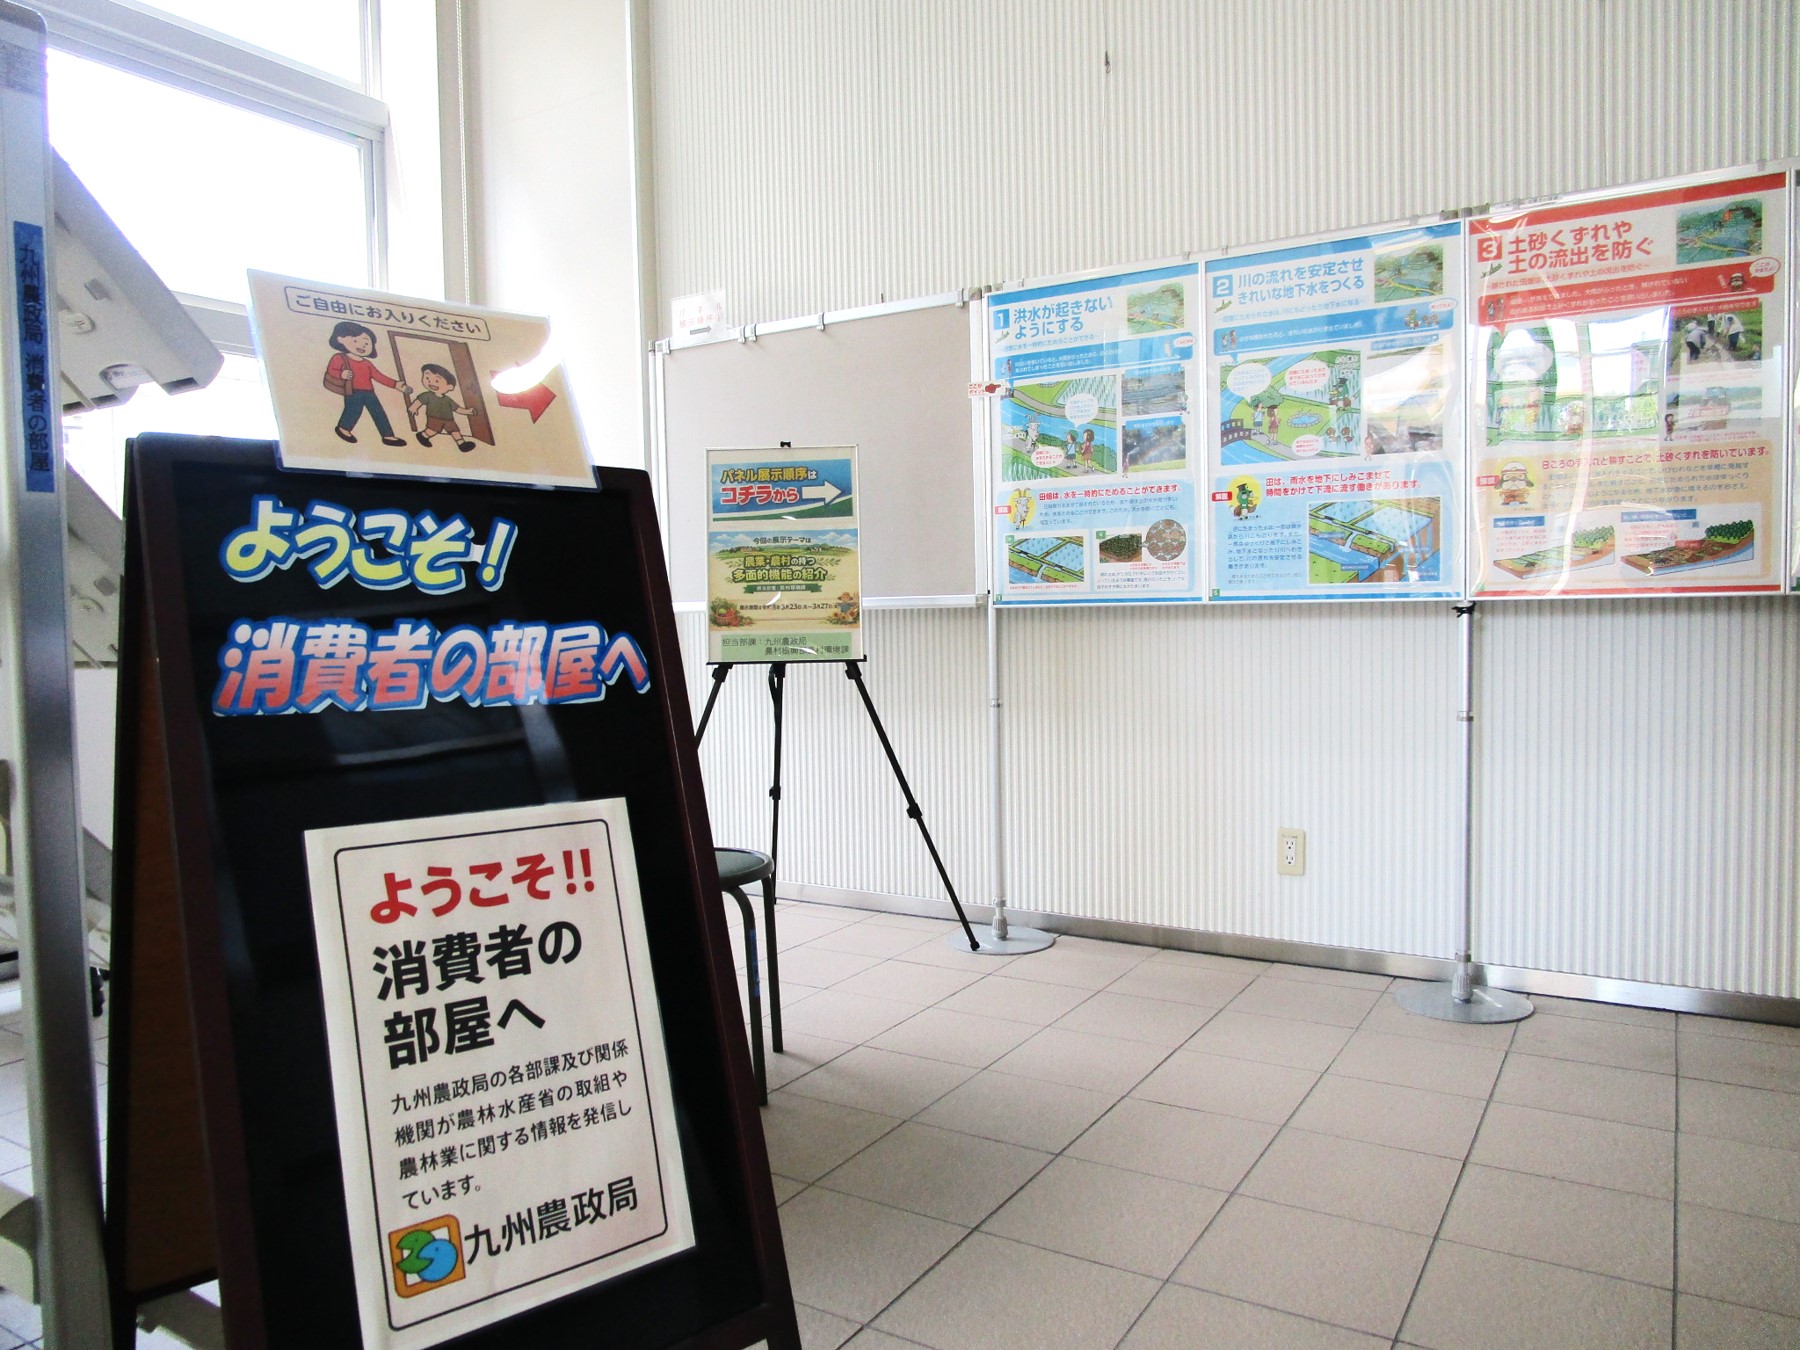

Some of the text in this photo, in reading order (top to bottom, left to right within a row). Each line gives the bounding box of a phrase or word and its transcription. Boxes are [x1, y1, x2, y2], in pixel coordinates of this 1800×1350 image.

[1482, 240, 1497, 258] 3
[1508, 221, 1632, 255] 土砂くずれや
[1508, 236, 1654, 274] 土の流出を防ぐ
[1216, 279, 1230, 295] 2
[1238, 257, 1364, 288] 川の流れを安定させ
[19, 243, 43, 345] 九州農政局
[1238, 276, 1365, 305] きれいな地下水をつくる
[294, 293, 482, 336] ご自由にお入りください
[1014, 296, 1113, 324] 洪水が起きない
[1015, 317, 1084, 339] ようにする
[720, 466, 818, 483] パネル展示順序は
[1266, 470, 1391, 486] 田は、雨水を地下にしみこませて
[1266, 480, 1422, 497] 時間をかけて下流に流す働きがあります。
[720, 484, 800, 505] コチラから
[1039, 484, 1182, 501] 田畑は、水を一時的にためることができます。
[1215, 492, 1229, 500] 解説
[753, 536, 811, 545] 今回の展示テーマは
[731, 567, 828, 582] 多面的機能の紹介
[744, 554, 816, 568] 農業・農村の持つ
[213, 619, 652, 715] 消費者の部屋へ
[372, 921, 582, 1001] 消費者の
[383, 997, 546, 1070] 部屋へ
[391, 1038, 629, 1116] 九州農政局の各部課及び関係
[394, 1069, 628, 1148] 機関が農林水産省の取組や
[398, 1102, 633, 1180] 農林業に関する情報を発信し
[402, 1174, 482, 1210] ています。
[464, 1175, 638, 1264] 九州農政局
